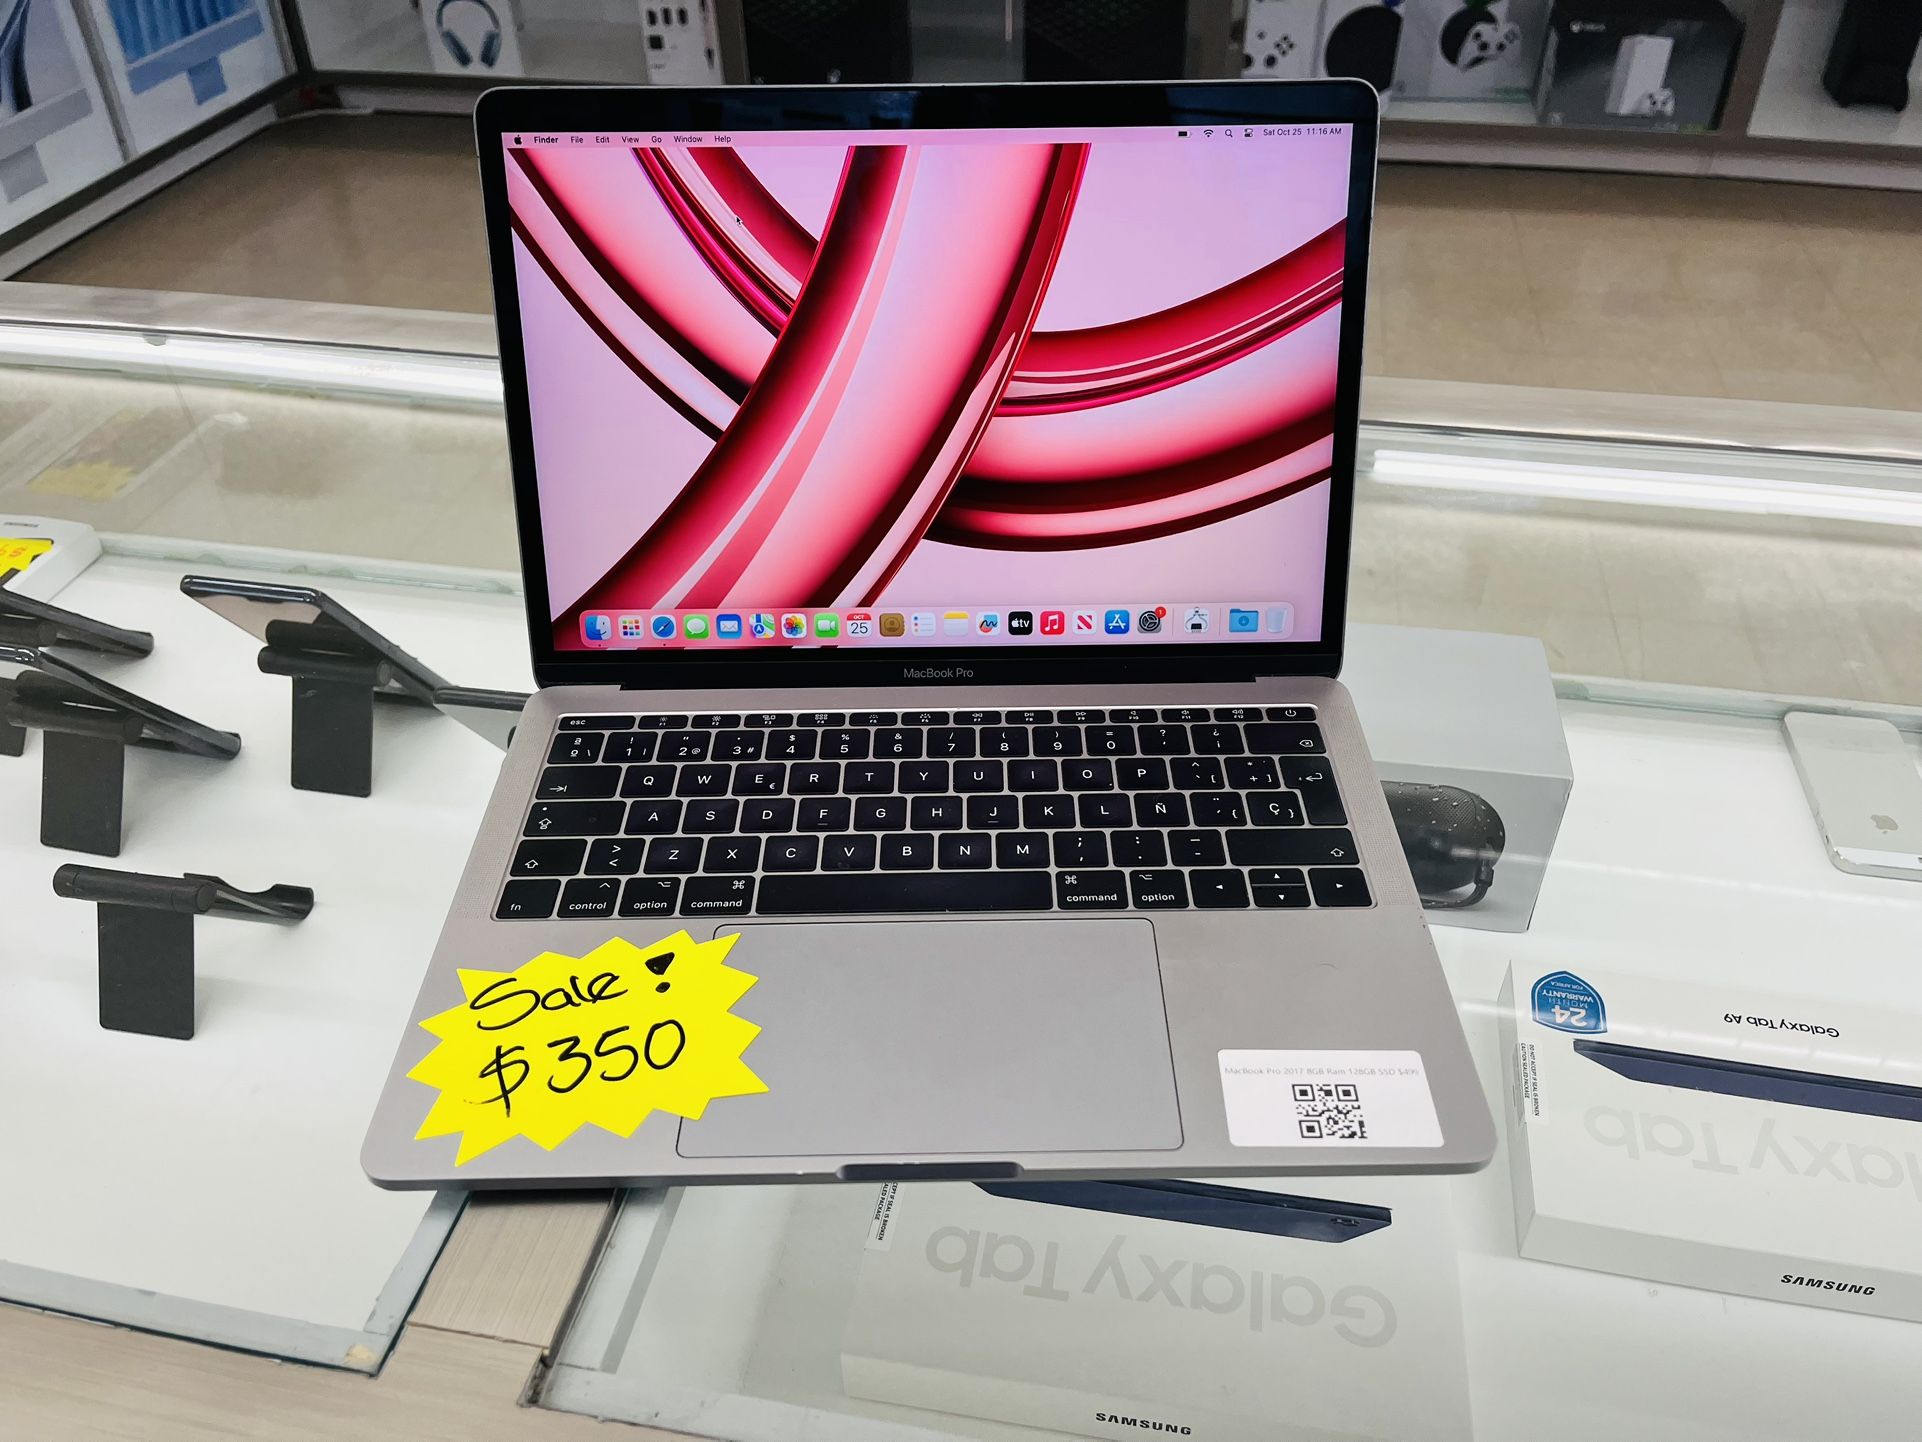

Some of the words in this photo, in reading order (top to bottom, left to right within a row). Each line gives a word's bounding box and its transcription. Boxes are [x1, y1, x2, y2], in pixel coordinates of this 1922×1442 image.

[534, 136, 559, 144] Finder
[570, 136, 584, 144] File
[595, 135, 610, 144] Edit
[621, 135, 640, 144] View
[651, 136, 662, 144] Go
[674, 135, 703, 144] Window
[714, 134, 732, 144] Help
[1263, 128, 1276, 136] Sat
[1276, 128, 1290, 136] Oct
[1290, 128, 1302, 136] 25
[1306, 128, 1328, 136] 11:16
[1329, 128, 1342, 136] AM
[850, 621, 869, 634] 25
[1020, 618, 1030, 628] tv
[903, 667, 954, 678] MacBook
[956, 667, 974, 678] Pro
[788, 734, 796, 742] $
[894, 732, 902, 740] &
[1159, 729, 1166, 737] ?
[626, 747, 632, 757] 1
[678, 746, 688, 756] 2
[732, 745, 742, 755] 3
[786, 745, 795, 754] 4
[840, 744, 849, 754] 5
[893, 743, 903, 753] 6
[947, 743, 956, 752] 7
[1000, 742, 1009, 752] 8
[1053, 741, 1063, 751] 9
[1106, 740, 1116, 750] 0
[643, 775, 654, 786] Q
[697, 775, 712, 785] W
[754, 774, 764, 784] E
[809, 773, 819, 783] R
[864, 772, 875, 782] T
[919, 771, 929, 781] Y
[973, 771, 984, 781] U
[1031, 770, 1035, 780] I
[1082, 769, 1093, 779] O
[1137, 768, 1147, 778] P
[647, 811, 659, 822] A
[705, 810, 716, 821] S
[762, 810, 773, 820] D
[819, 809, 829, 819] F
[875, 808, 886, 818] G
[931, 807, 943, 817] H
[989, 806, 997, 817] J
[1044, 806, 1054, 816] K
[1100, 805, 1110, 815] L
[1155, 802, 1167, 814] Ñ
[1269, 802, 1280, 816] Ç
[668, 849, 680, 860] Z
[726, 848, 738, 859] X
[785, 847, 797, 858] C
[843, 846, 855, 857] V
[902, 845, 913, 857] B
[959, 845, 971, 856] N
[1016, 844, 1030, 855] M
[510, 902, 522, 912] fn
[568, 901, 607, 910] control
[633, 900, 668, 910] option
[690, 899, 743, 908] command
[1066, 893, 1118, 902] command
[1141, 893, 1175, 903] option
[469, 972, 629, 1031] Sale
[1542, 989, 1594, 1003] WARRANTY
[1548, 998, 1588, 1009] MONTH
[1551, 1004, 1588, 1027] 24
[1723, 1013, 1742, 1025] A9
[1746, 1016, 1778, 1030] Tab
[1779, 1018, 1840, 1038] Galaxy
[464, 1018, 686, 1118] $350
[1583, 1105, 1741, 1176] Tab
[874, 1196, 886, 1221] PACKAGE
[886, 1200, 894, 1212] SEAL
[878, 1218, 888, 1240] BROKEN
[925, 1225, 1074, 1302] Tab
[1082, 1234, 1398, 1348] Galaxy
[1780, 1273, 1876, 1296] SAMSUNG
[1094, 1411, 1192, 1436] SAMSUNG
